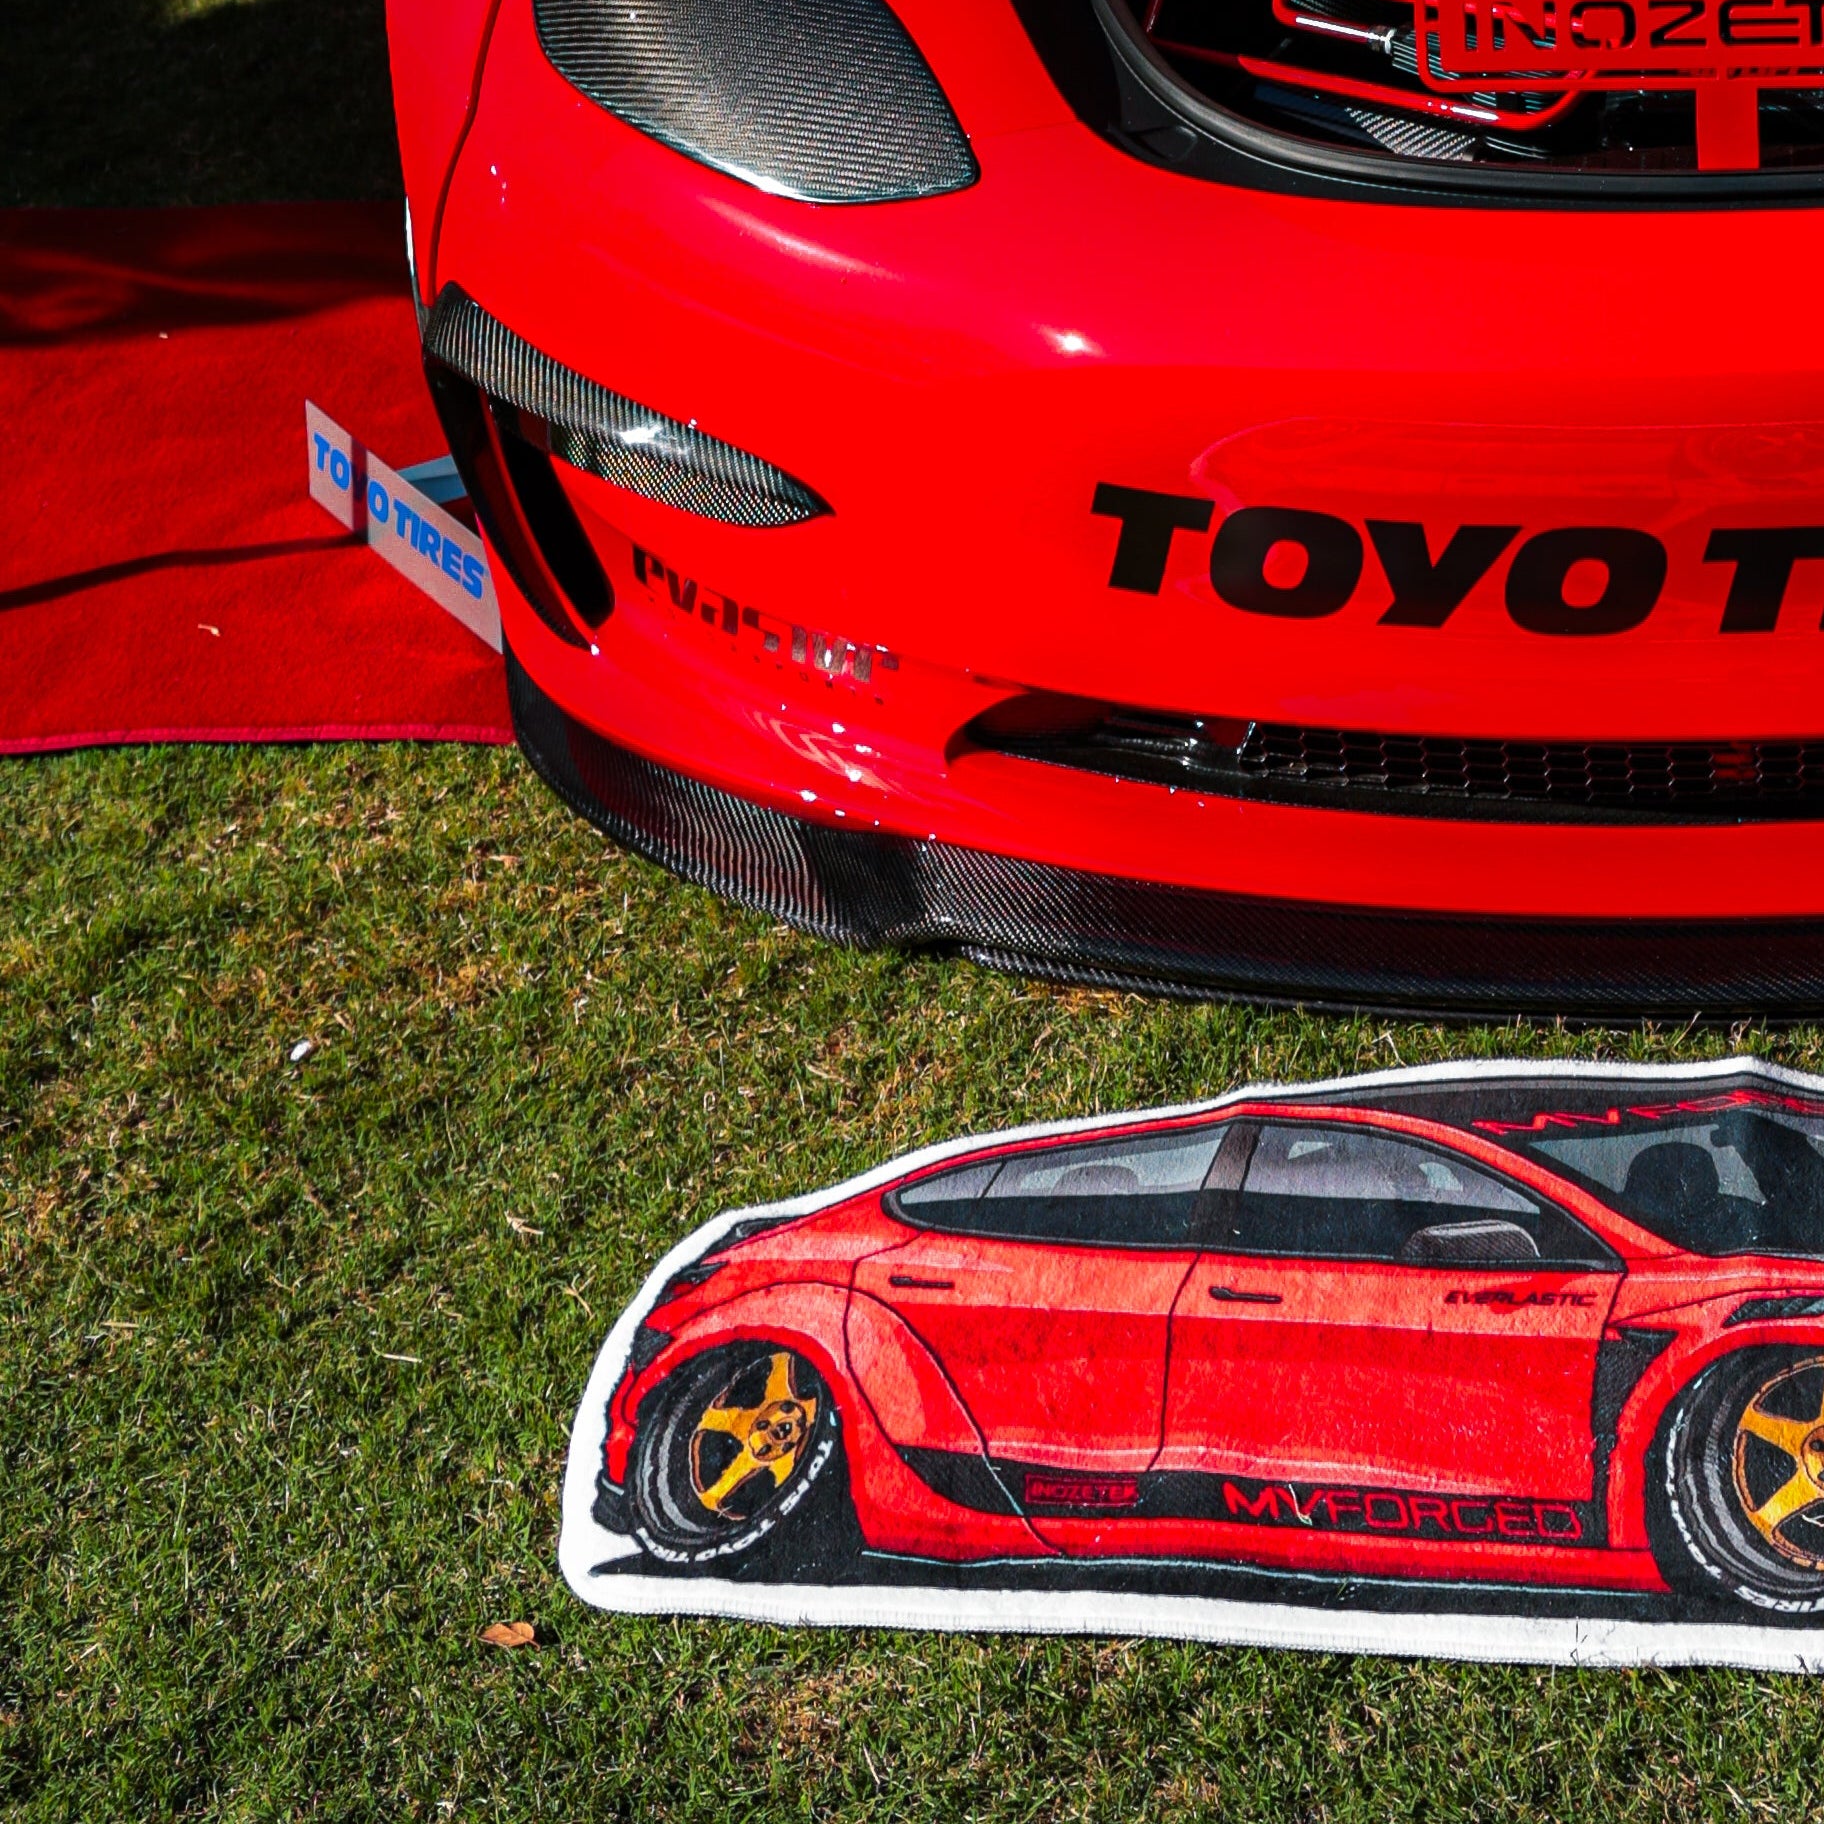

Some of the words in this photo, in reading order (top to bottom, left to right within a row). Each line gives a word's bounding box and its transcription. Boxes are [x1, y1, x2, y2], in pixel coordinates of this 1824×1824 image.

[313, 431, 389, 523] TOYO
[393, 498, 484, 600] TIRES
[1091, 481, 1667, 637] TOYO
[1221, 1479, 1583, 1540] MVFORGED
